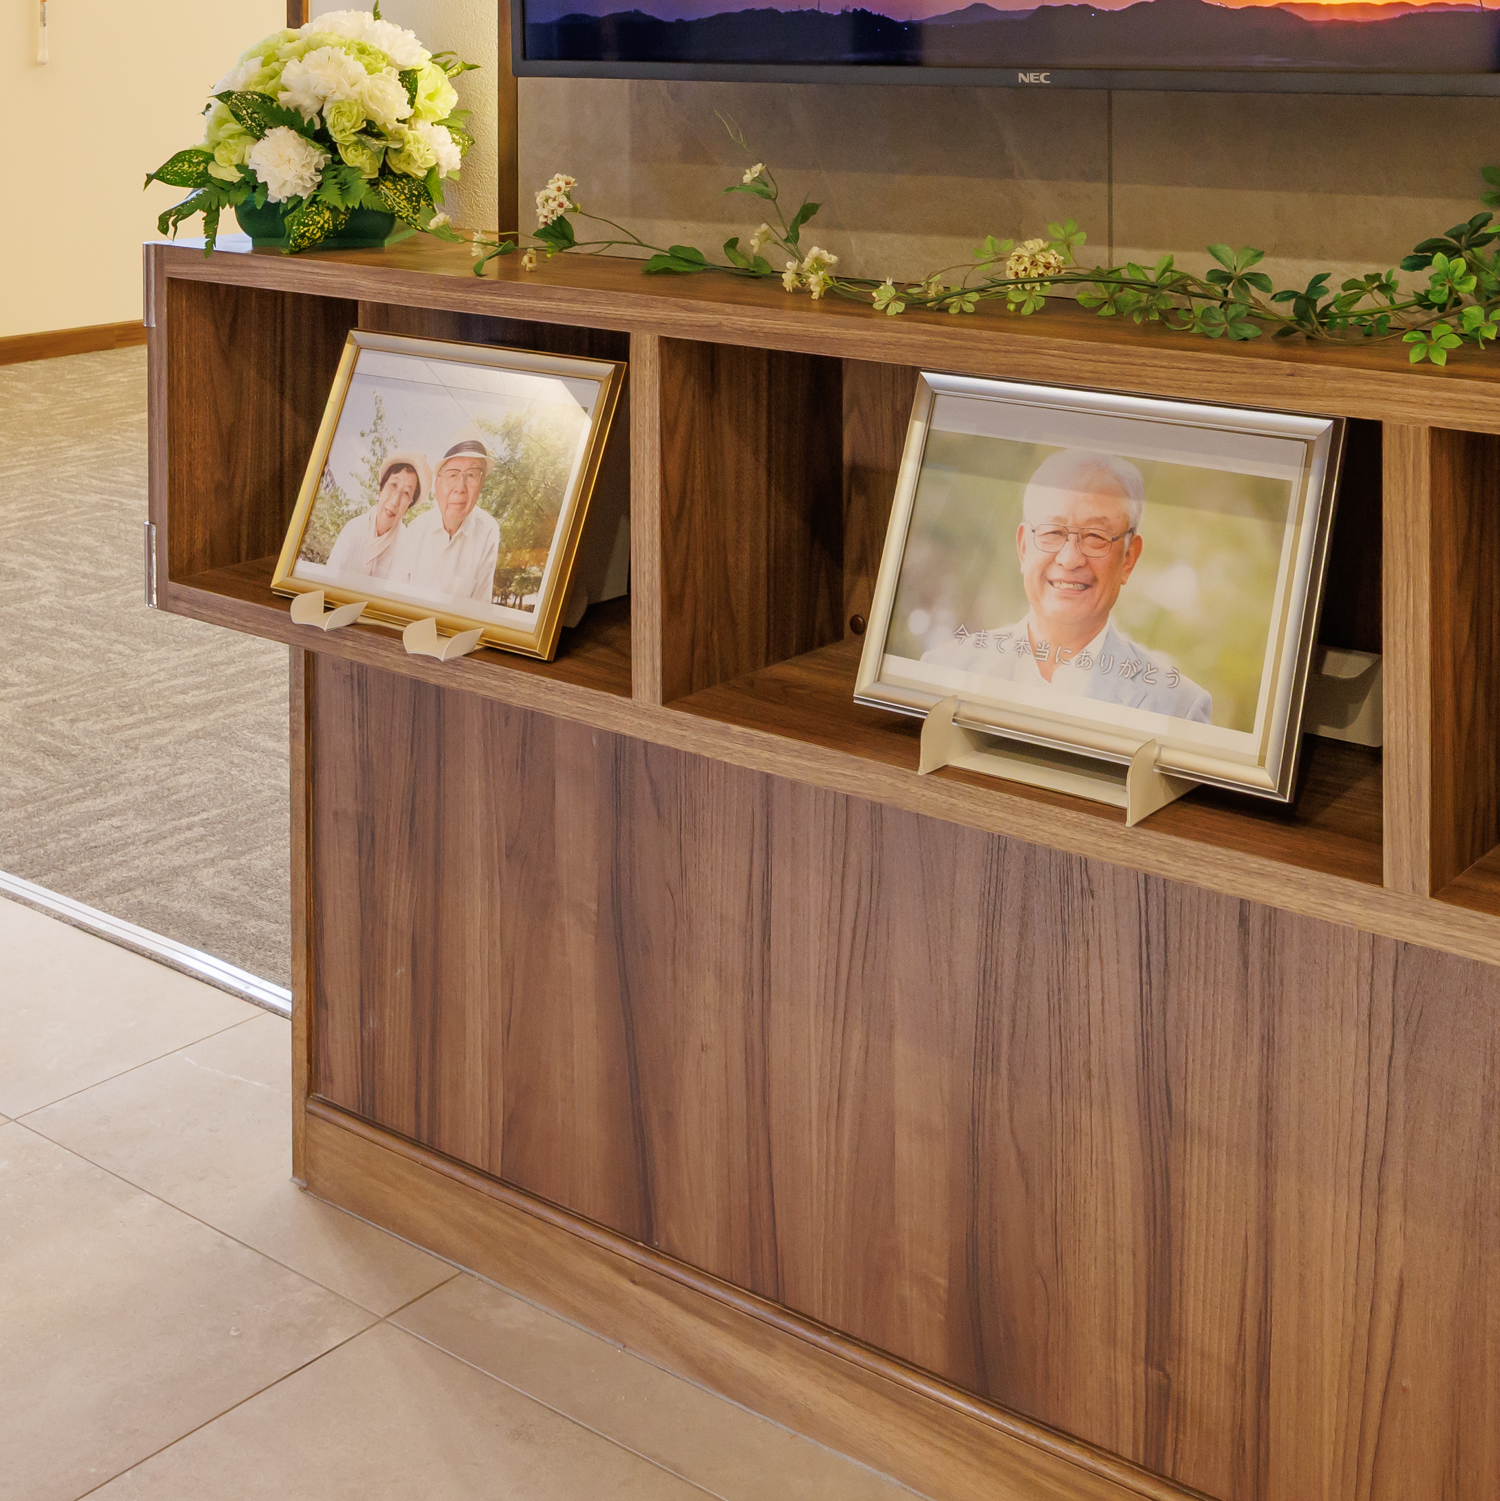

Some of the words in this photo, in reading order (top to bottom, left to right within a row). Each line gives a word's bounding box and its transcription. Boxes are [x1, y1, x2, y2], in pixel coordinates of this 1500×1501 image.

[1018, 72, 1051, 84] NEC
[953, 623, 1181, 689] 今まで本当にありがとう
